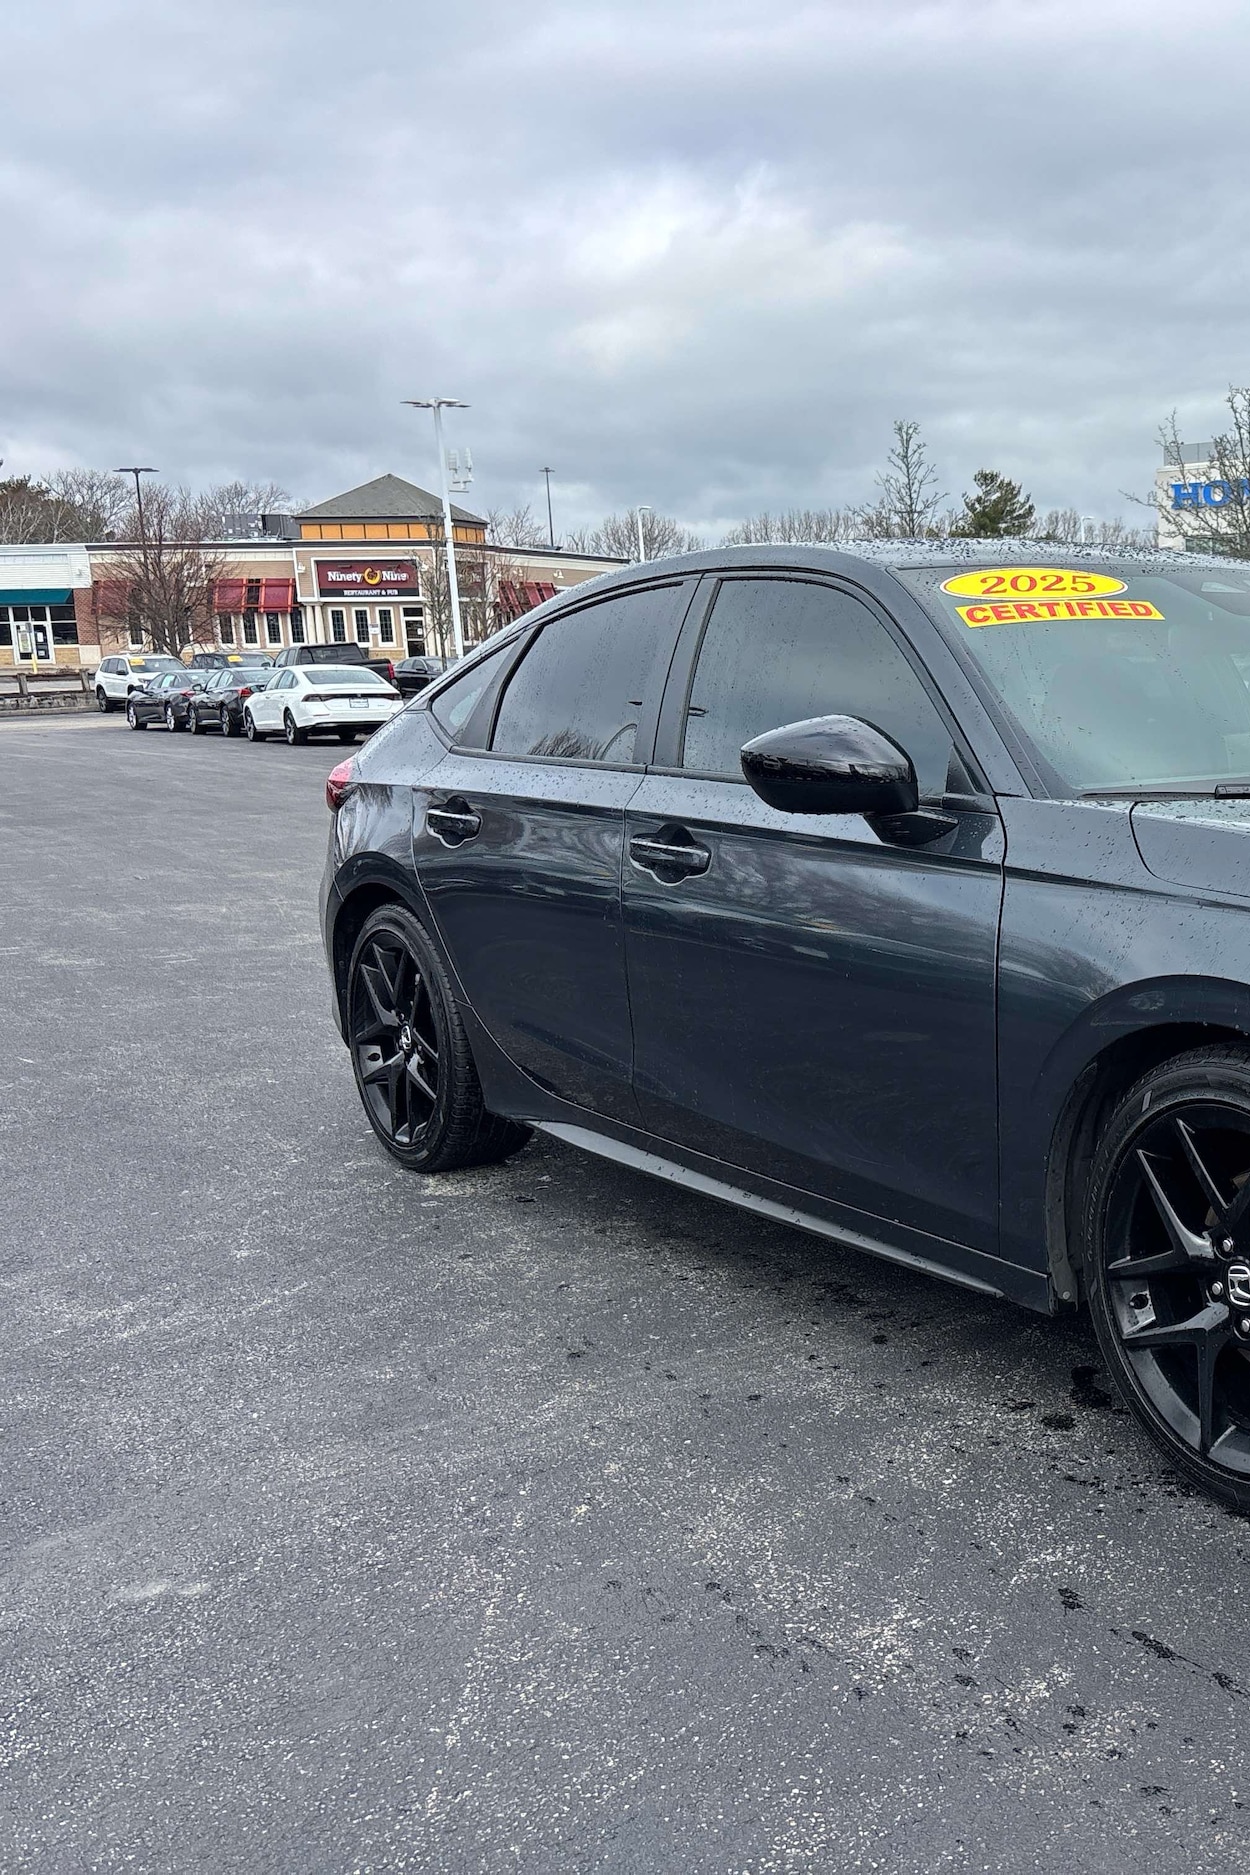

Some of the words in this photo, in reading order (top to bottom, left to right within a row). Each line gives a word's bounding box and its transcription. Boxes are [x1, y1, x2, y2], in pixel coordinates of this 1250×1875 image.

[327, 570, 362, 583] Ninety
[381, 570, 407, 581] Nine
[979, 574, 1096, 595] 2025
[965, 601, 1154, 624] CERTIFIED
